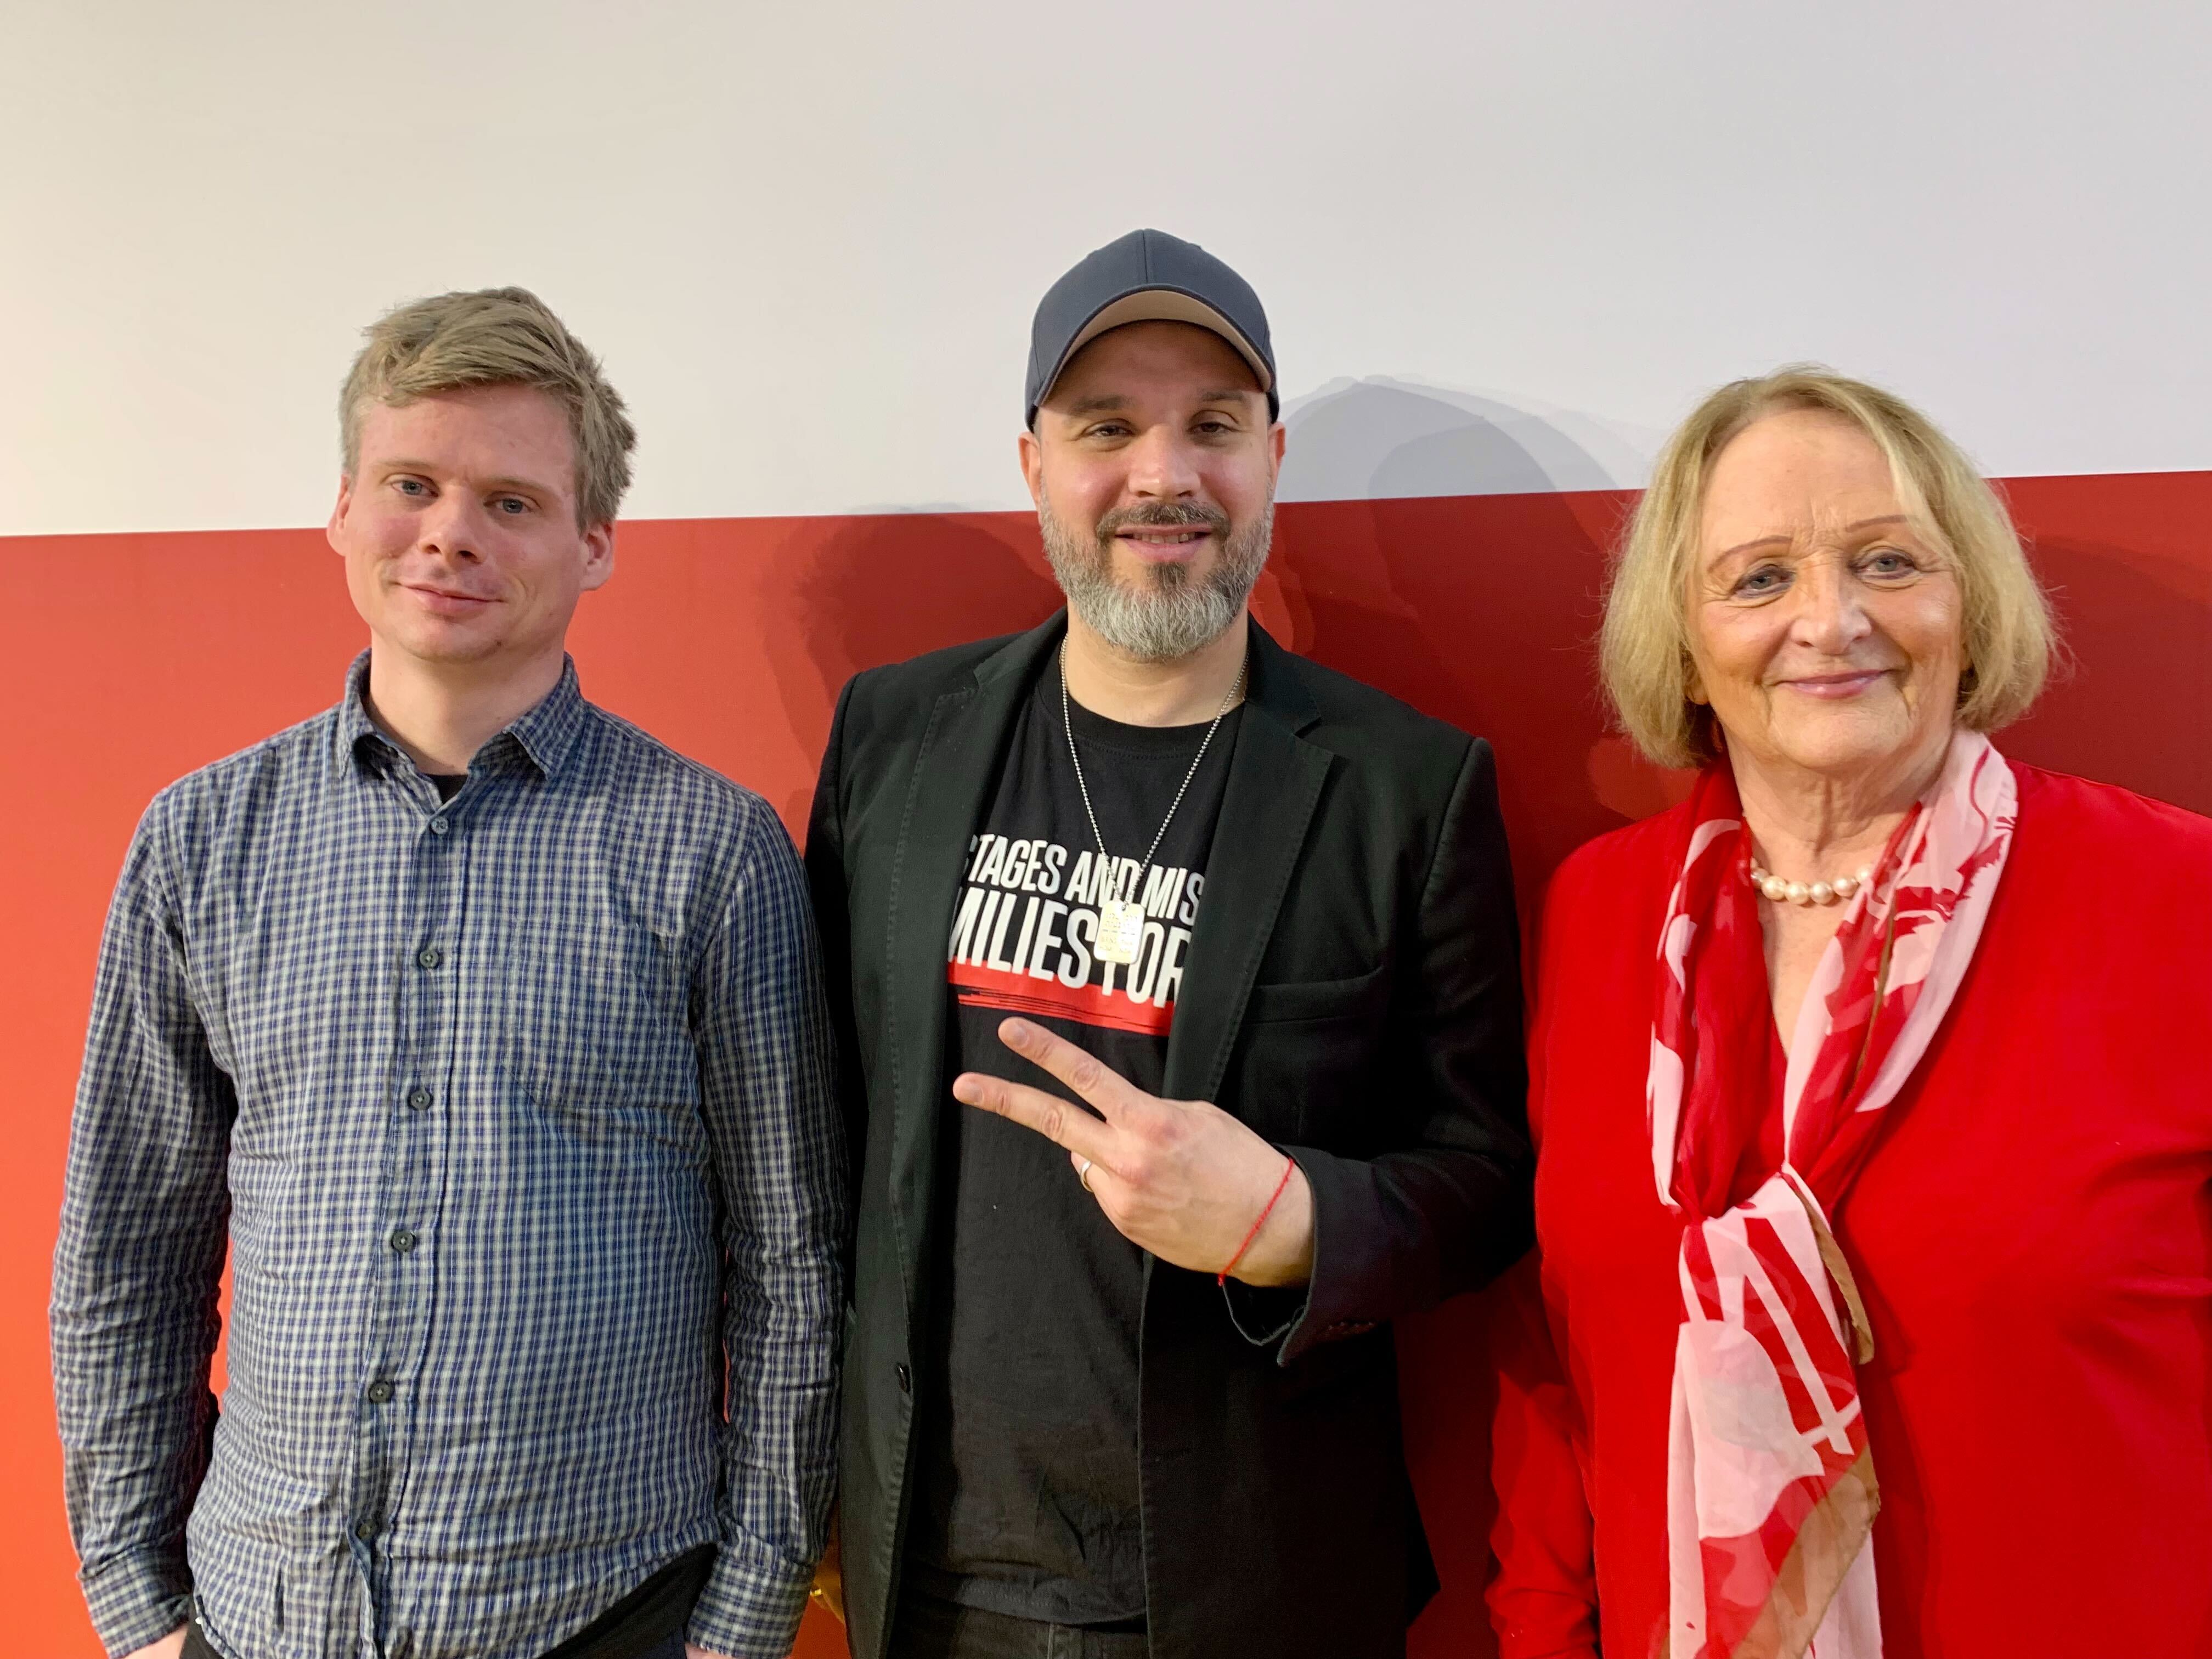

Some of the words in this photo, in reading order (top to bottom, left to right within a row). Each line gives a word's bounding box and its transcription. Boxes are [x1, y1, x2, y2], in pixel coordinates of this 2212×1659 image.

[963, 833, 1068, 894] TAGES
[1064, 850, 1141, 909] AND
[1141, 864, 1205, 926] MIS
